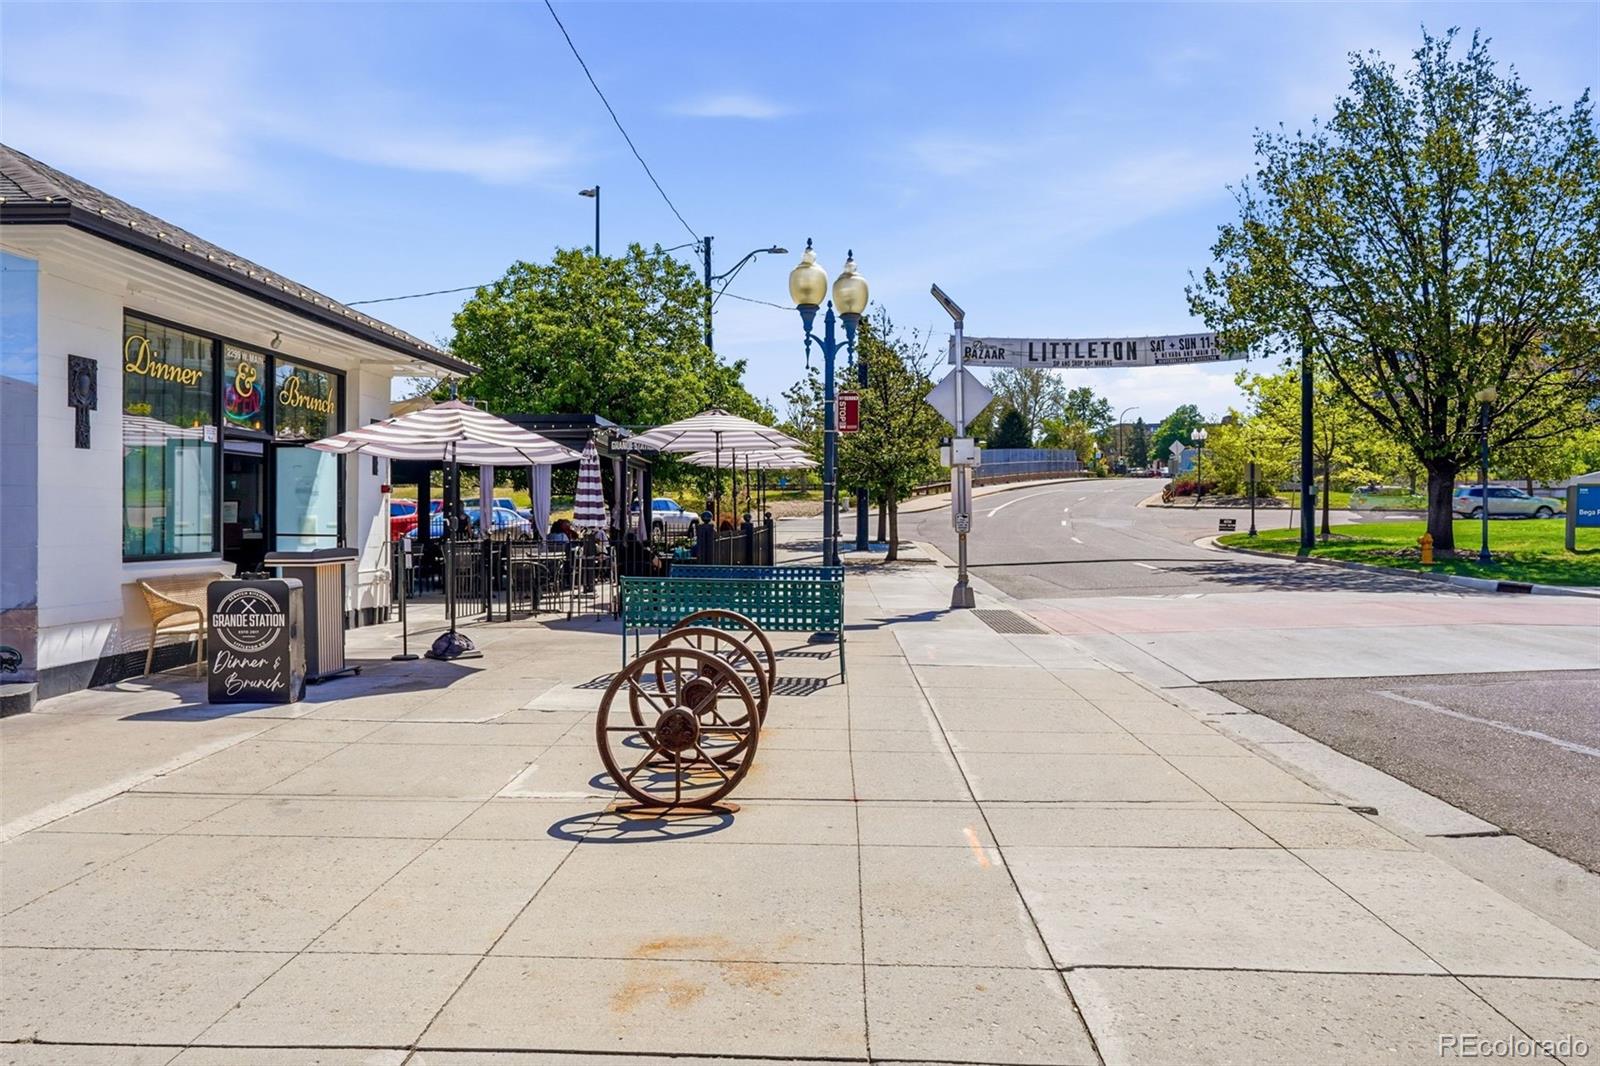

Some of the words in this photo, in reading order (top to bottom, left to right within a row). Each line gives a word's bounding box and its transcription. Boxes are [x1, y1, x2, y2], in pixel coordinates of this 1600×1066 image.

[964, 346, 1006, 360] BAZAAR
[1028, 341, 1137, 362] LITTLETON
[1150, 340, 1166, 352] SAT
[1179, 337, 1197, 350] SUN
[125, 335, 202, 385] Dinner
[235, 362, 257, 397] &
[279, 375, 335, 414] Brunch
[1579, 509, 1596, 517] Bega
[212, 613, 248, 627] GRANDE
[249, 613, 285, 627] STATION
[212, 649, 268, 674] Dinner
[225, 672, 285, 696] Brunch
